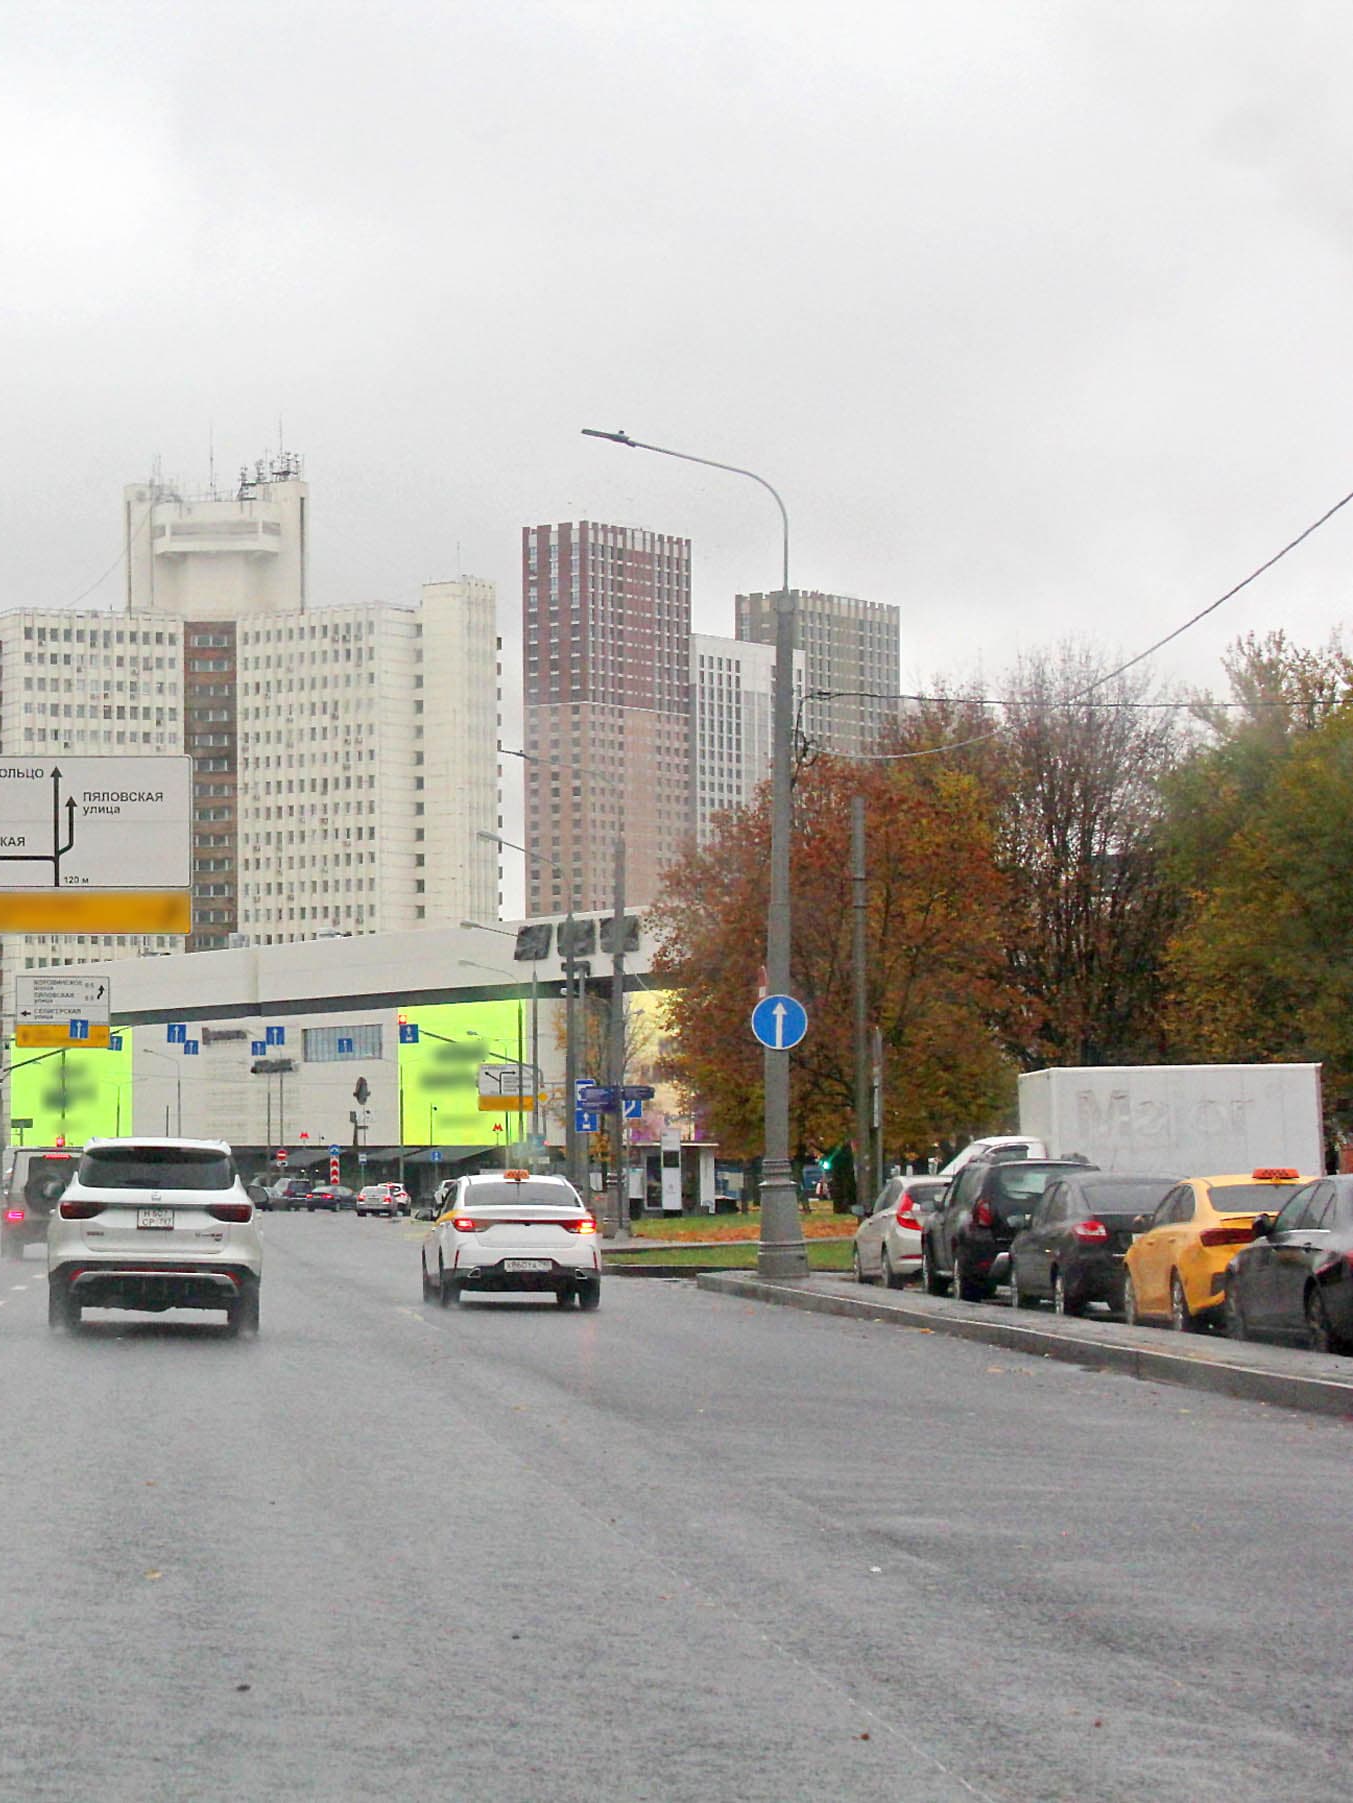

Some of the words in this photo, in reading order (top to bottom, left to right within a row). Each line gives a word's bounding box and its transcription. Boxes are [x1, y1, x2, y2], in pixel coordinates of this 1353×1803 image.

[83, 791, 164, 803] ПЯЛОВСКАЯ
[83, 805, 121, 816] улица
[64, 876, 79, 884] 120
